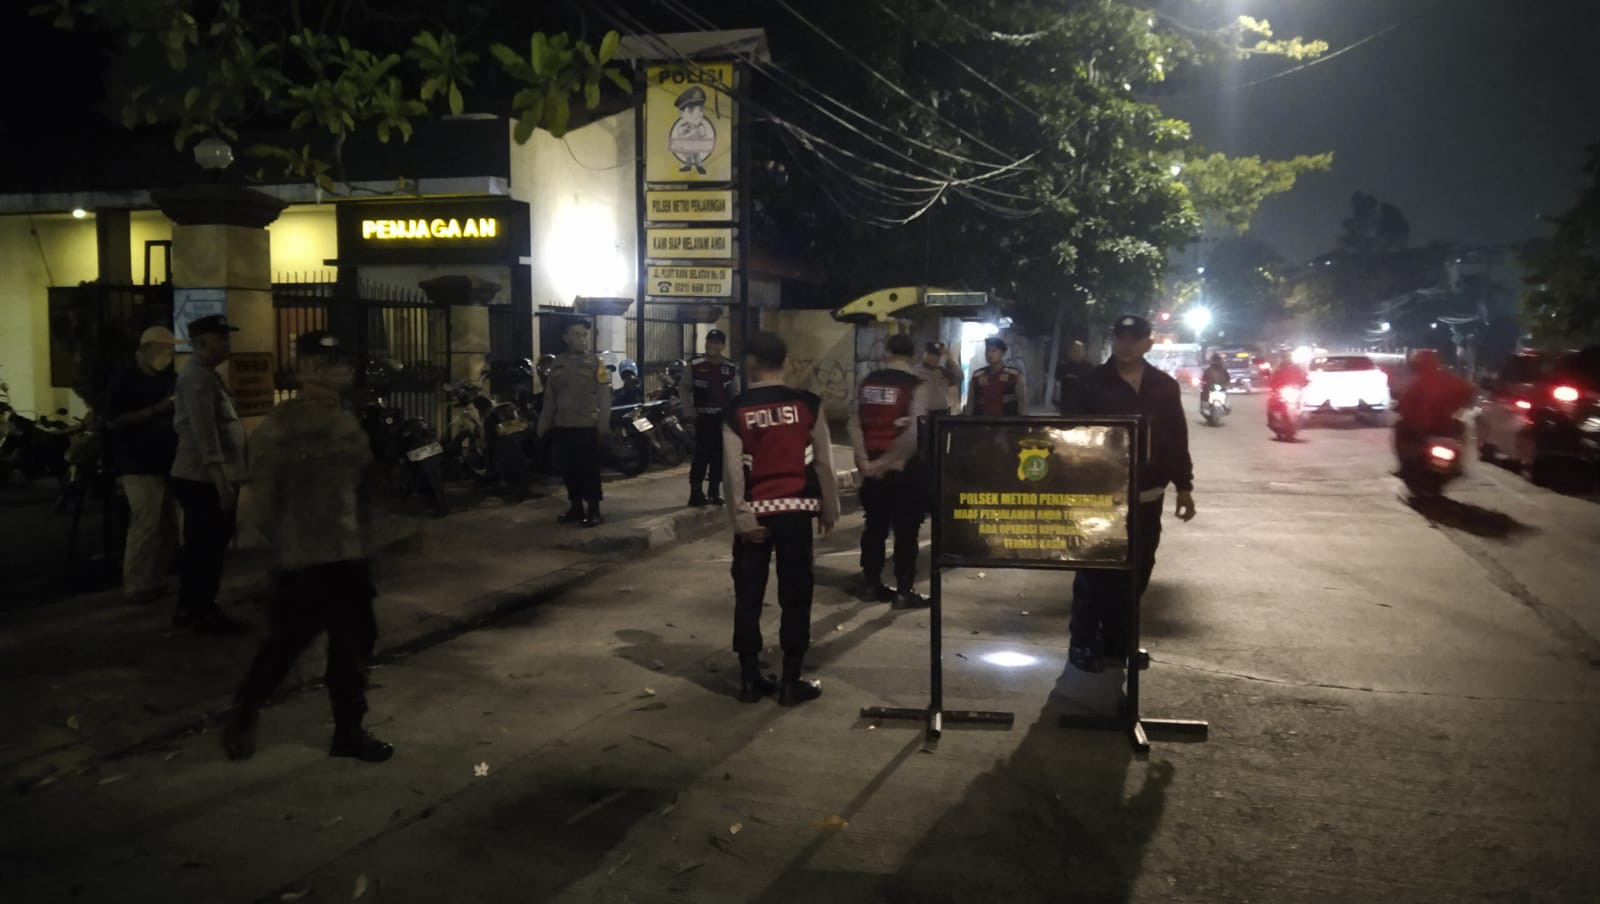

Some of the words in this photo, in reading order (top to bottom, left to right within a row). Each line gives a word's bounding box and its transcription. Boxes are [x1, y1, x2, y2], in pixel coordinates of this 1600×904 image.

[659, 68, 723, 84] POLISI
[673, 199, 690, 213] METRO
[362, 218, 497, 239] PENJAGAAN
[669, 236, 682, 250] SIAP
[711, 236, 726, 250] ANDA
[744, 405, 799, 430] POLISI
[960, 492, 999, 505] POLSEK
[1001, 492, 1037, 505] METRO
[954, 508, 978, 519] MAAF
[1037, 510, 1062, 520] ANDA
